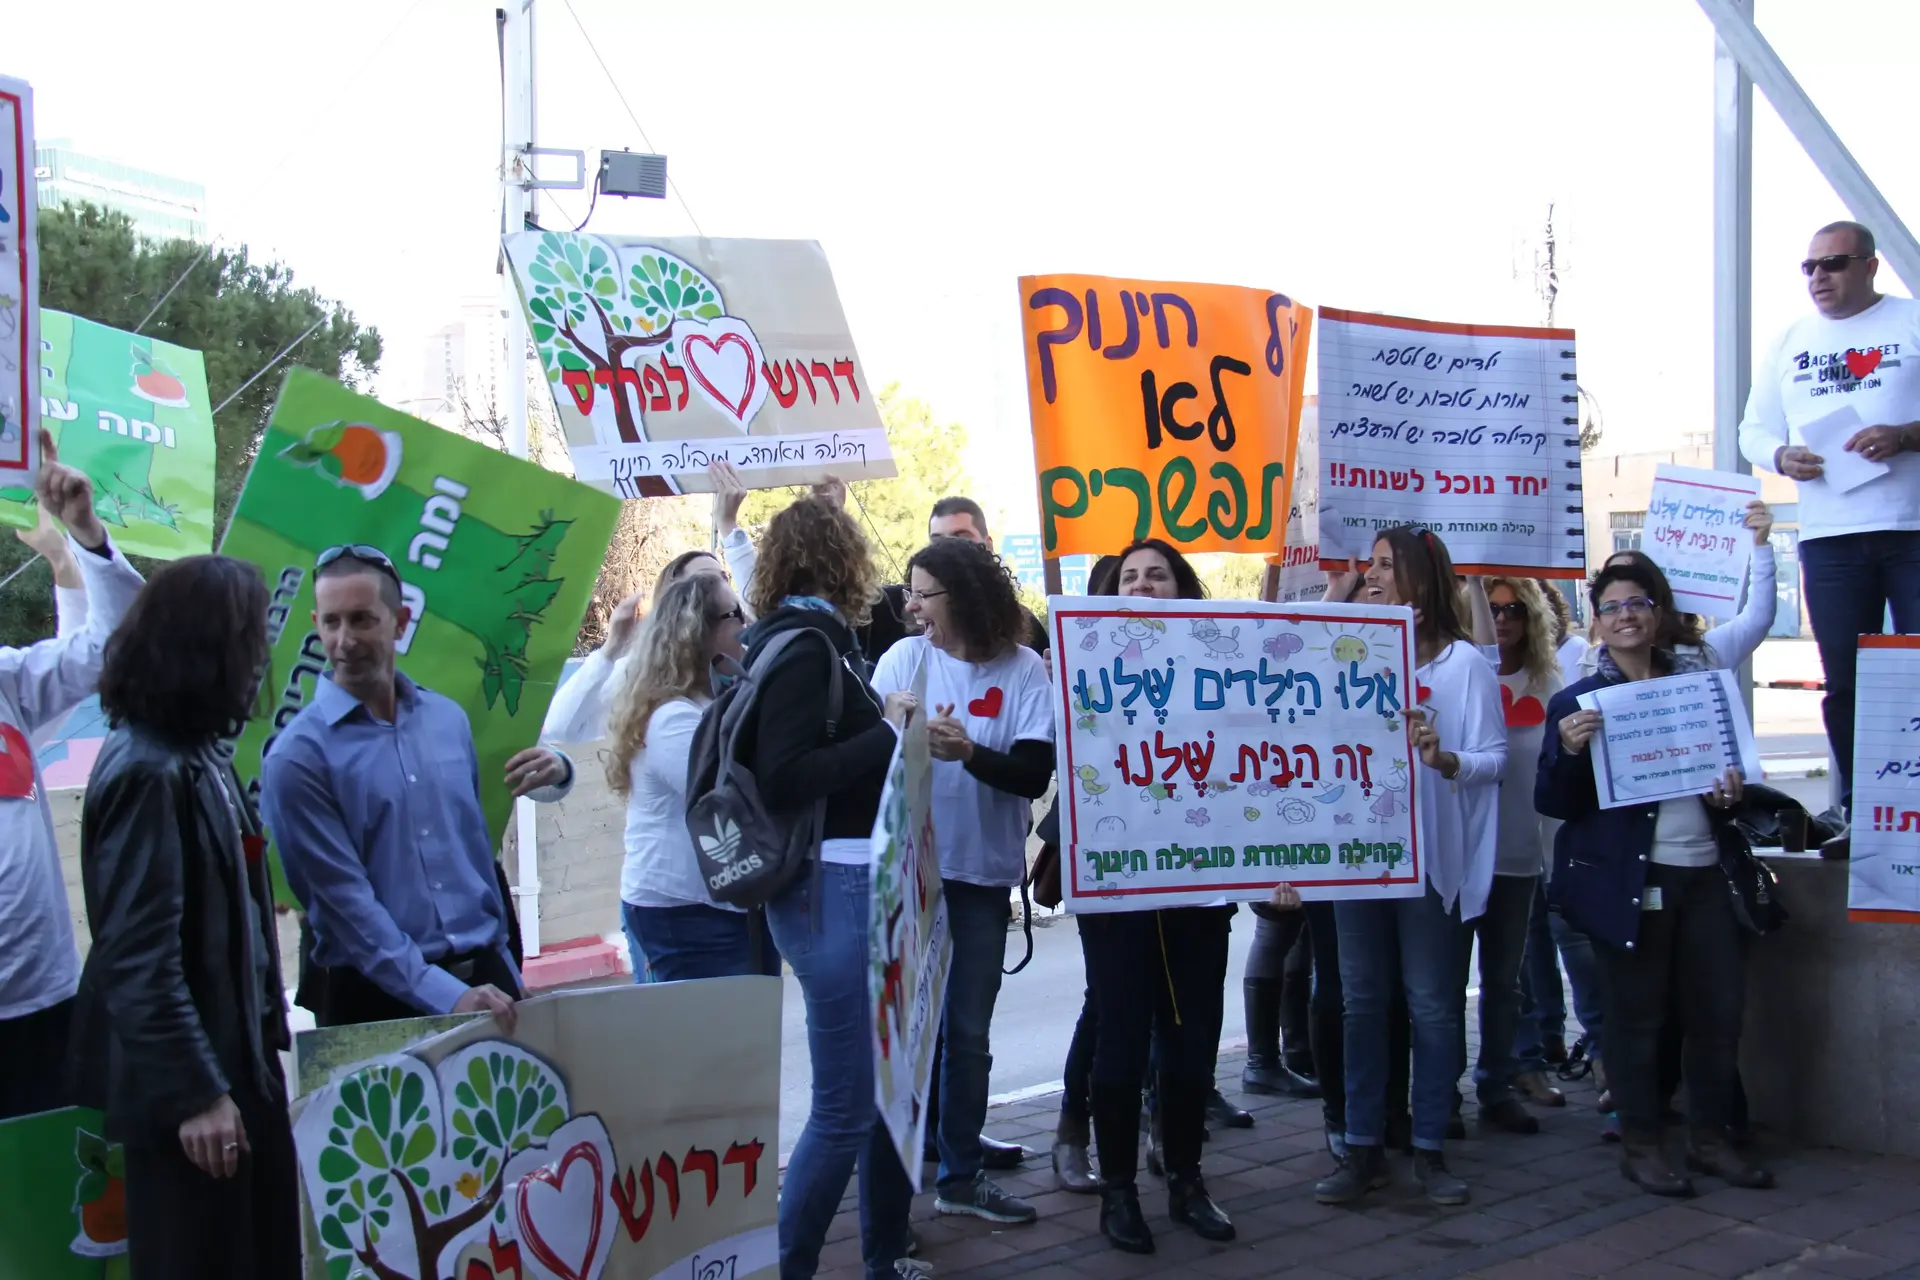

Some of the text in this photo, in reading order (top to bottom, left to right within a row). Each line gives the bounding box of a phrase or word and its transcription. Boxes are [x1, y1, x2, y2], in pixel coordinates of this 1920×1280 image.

[1029, 288, 1198, 404] חינוך
[1424, 352, 1443, 371] יש
[1447, 351, 1502, 374] ילדים
[1819, 364, 1875, 383] UND
[562, 351, 861, 417] דרוש לפרדס
[1396, 387, 1414, 405] יש
[1141, 355, 1251, 452] לא
[1415, 388, 1477, 408] טובות
[1476, 392, 1530, 411] מורות
[98, 408, 178, 449] ומה
[1406, 426, 1424, 444] יש
[1432, 425, 1487, 446] טובה
[1492, 425, 1546, 455] קהילה
[738, 441, 805, 466] מאוחדת
[815, 433, 867, 468] קהילה
[1330, 463, 1548, 496] יחד נוכל לשנות!!
[408, 475, 470, 571] ומה
[1343, 515, 1367, 528] ראוי
[1448, 521, 1498, 534] מאוחדת
[1501, 520, 1536, 537] קהילה
[1086, 838, 1403, 880] קהילה מאוחדת מובילה חינוך
[710, 853, 763, 891] adidas
[610, 1136, 766, 1243] דרוש
